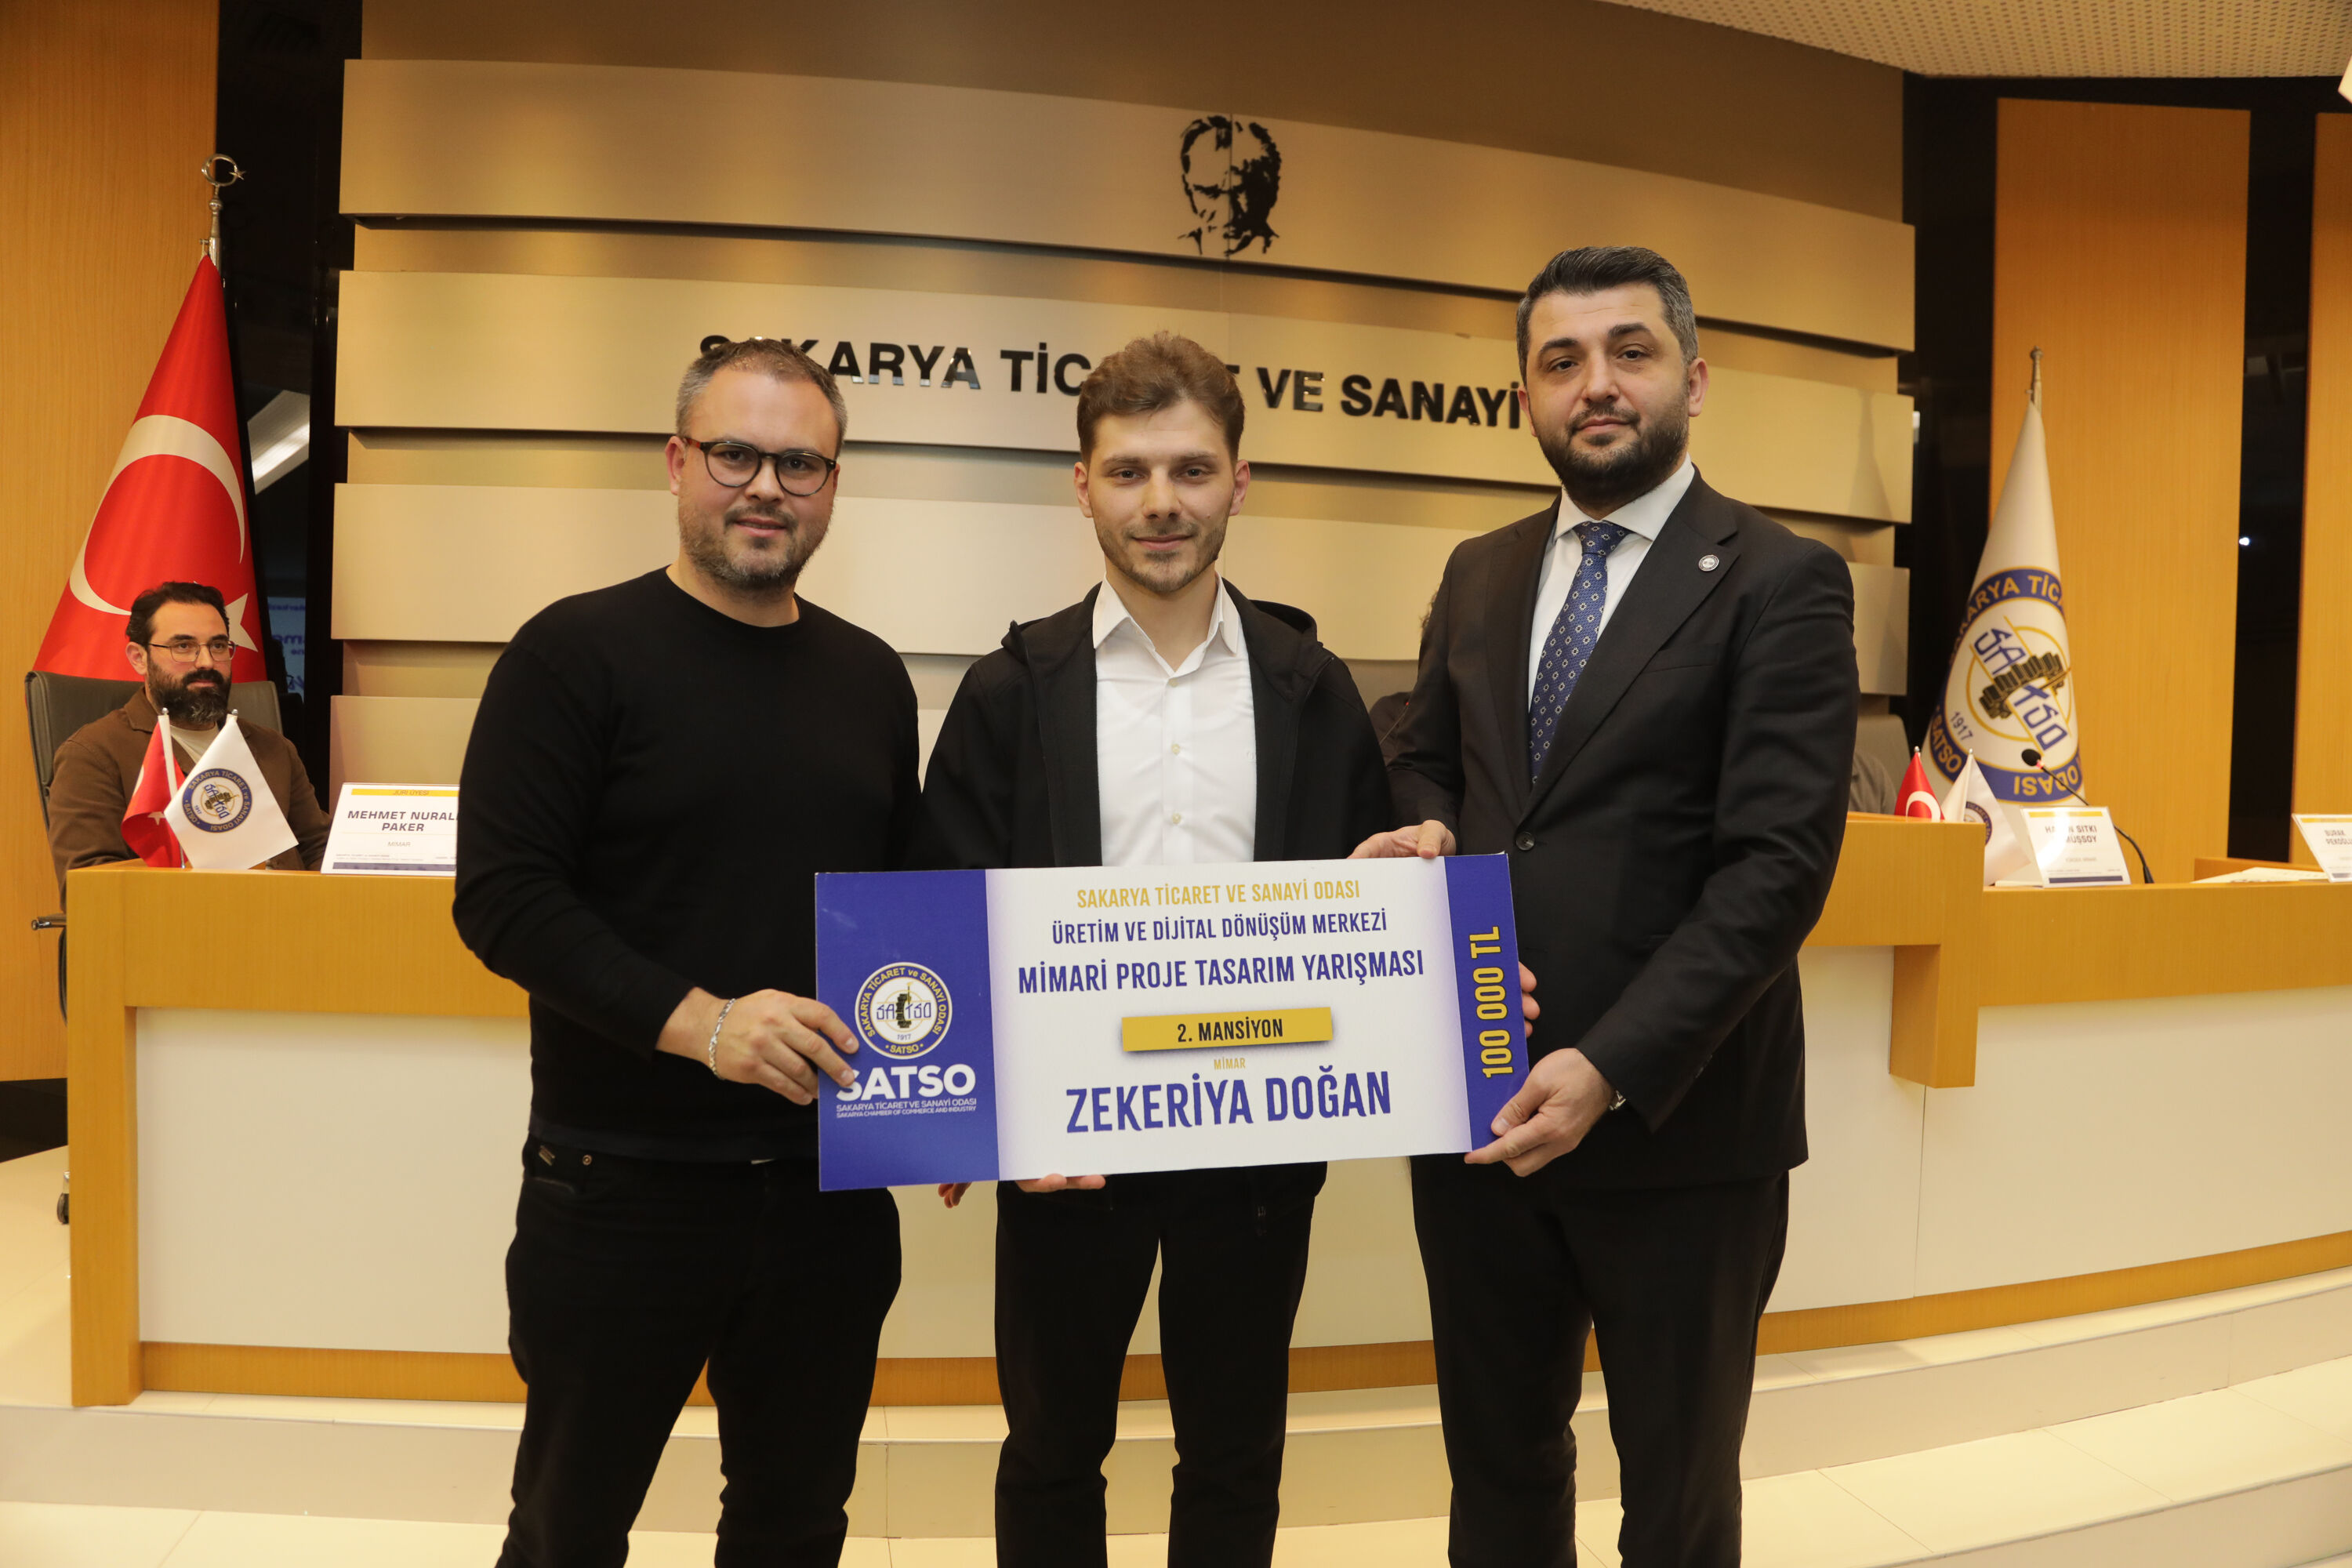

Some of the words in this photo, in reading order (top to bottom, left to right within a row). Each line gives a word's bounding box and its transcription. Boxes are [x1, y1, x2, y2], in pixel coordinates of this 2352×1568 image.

[1256, 366, 1323, 412] VE
[1340, 374, 1520, 430] SANAYİ
[1950, 711, 1974, 741] 1917
[1932, 715, 1962, 773] SATSO
[2013, 764, 2078, 796] ODASI
[183, 804, 198, 822] SATSO
[189, 771, 220, 790] SAKARYA
[210, 822, 234, 831] ODASI
[347, 811, 406, 820] MEHMET
[410, 811, 459, 821] NURAL
[382, 822, 425, 832] PAKER
[1076, 887, 1150, 908] SAKARYA
[1155, 883, 1221, 906] TİCARET
[1226, 884, 1246, 902] VE
[1251, 878, 1308, 902] SANAYİ
[1314, 880, 1360, 899] ODASI
[1052, 919, 1119, 944] ÜRETİM
[1125, 921, 1147, 942] VE
[1153, 916, 1217, 940] DİJİTAL
[1222, 912, 1306, 941] DÖNÜŞÜM
[1312, 907, 1387, 934] MERKEZİ
[1468, 925, 1502, 959] TL
[868, 967, 906, 991] TİCARET
[1018, 958, 1107, 993] MİMARİ
[1116, 960, 1187, 989] PROJE
[1195, 956, 1294, 985] TASARIM
[1301, 949, 1424, 985] YARIŞMASI
[920, 973, 946, 1002] SANAYİ
[1472, 967, 1508, 1020] 000
[860, 992, 876, 1037] SAKARYA
[932, 1004, 946, 1035] ODASI
[1178, 1024, 1192, 1043] 2.
[1198, 1016, 1283, 1041] MANSİYON
[890, 1044, 919, 1054] SATSO
[1214, 1056, 1246, 1070] MİMAR
[1479, 1029, 1514, 1078] 100
[836, 1064, 976, 1102] SATSO
[837, 1103, 874, 1112] SAKARYA
[875, 1101, 907, 1110] TİCARET
[921, 1098, 951, 1107] SANAYİ
[952, 1098, 977, 1106] ODASI
[1066, 1073, 1254, 1134] ZEKERİYA
[1265, 1065, 1391, 1122] DOĞAN
